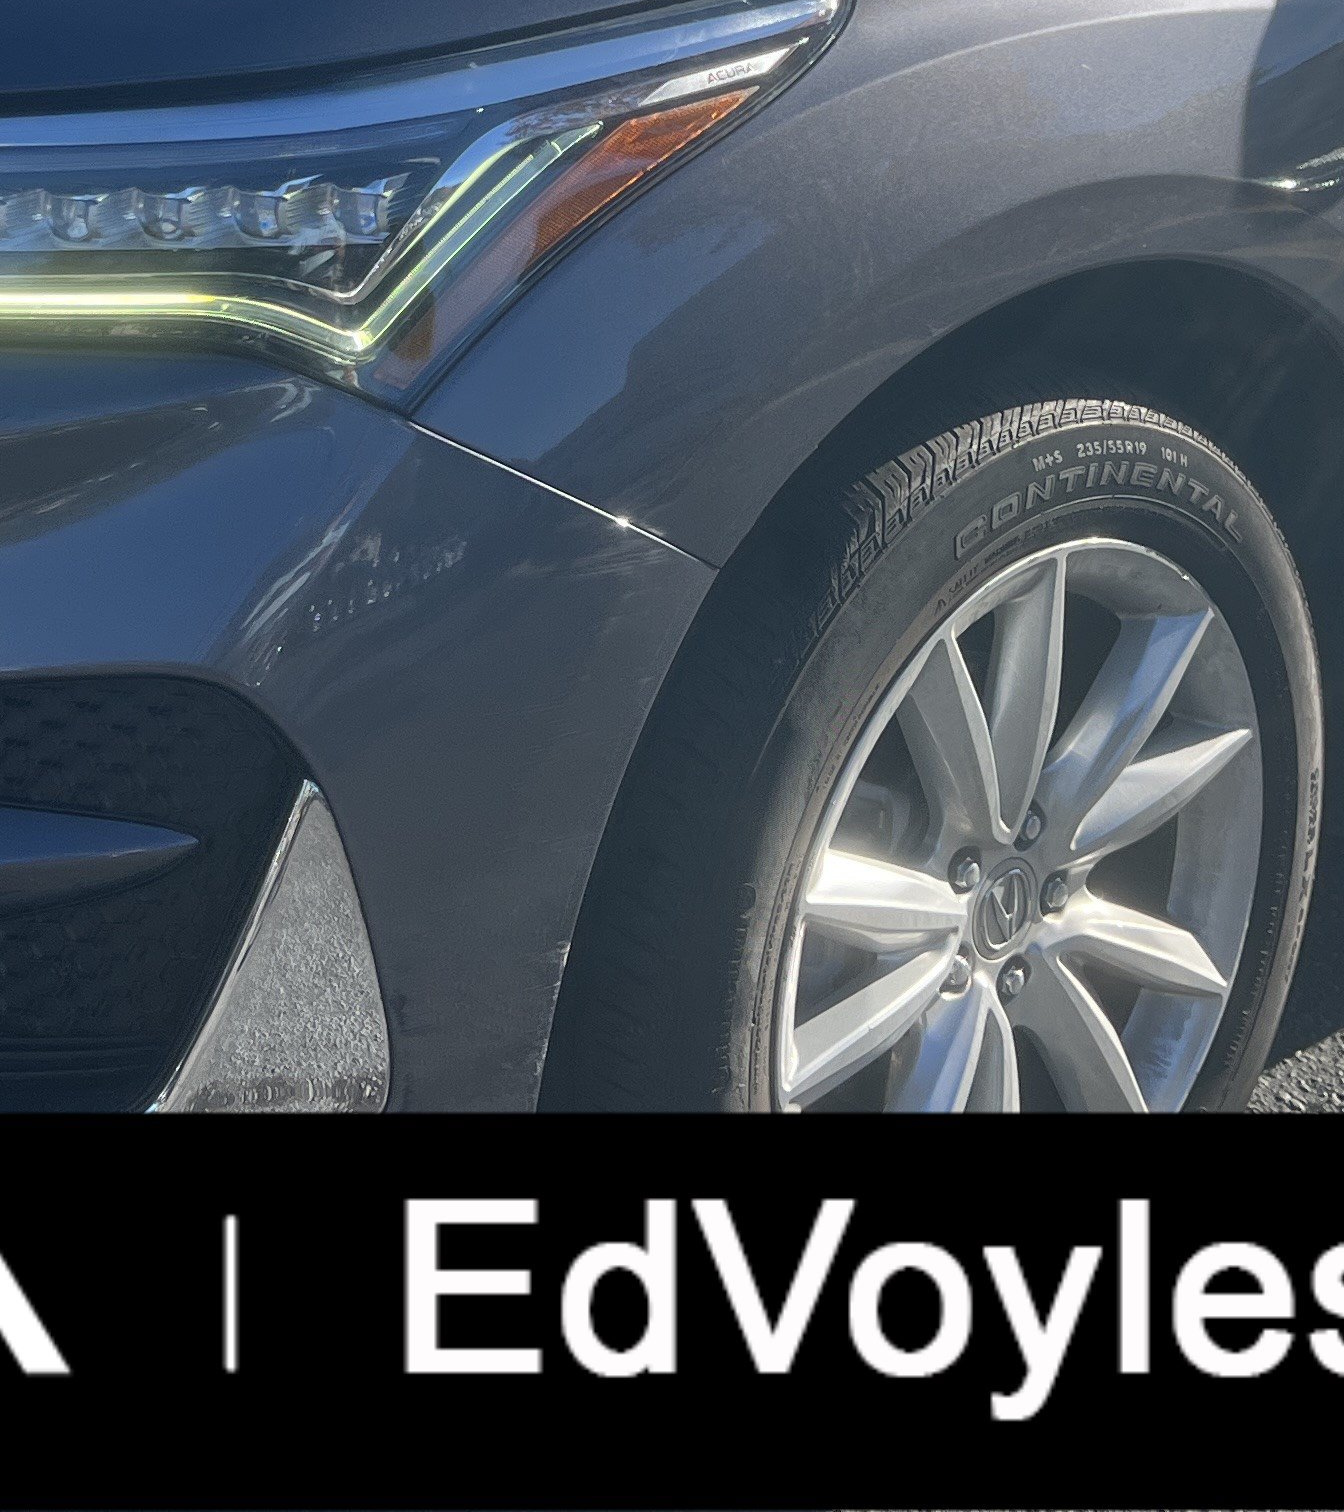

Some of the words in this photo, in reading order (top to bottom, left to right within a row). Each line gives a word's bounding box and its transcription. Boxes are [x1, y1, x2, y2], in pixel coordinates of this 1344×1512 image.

[707, 62, 755, 85] ACURA
[1032, 450, 1063, 472] M+S
[1076, 439, 1148, 458] 235/55R19
[955, 460, 1244, 561] CONTINENTAL
